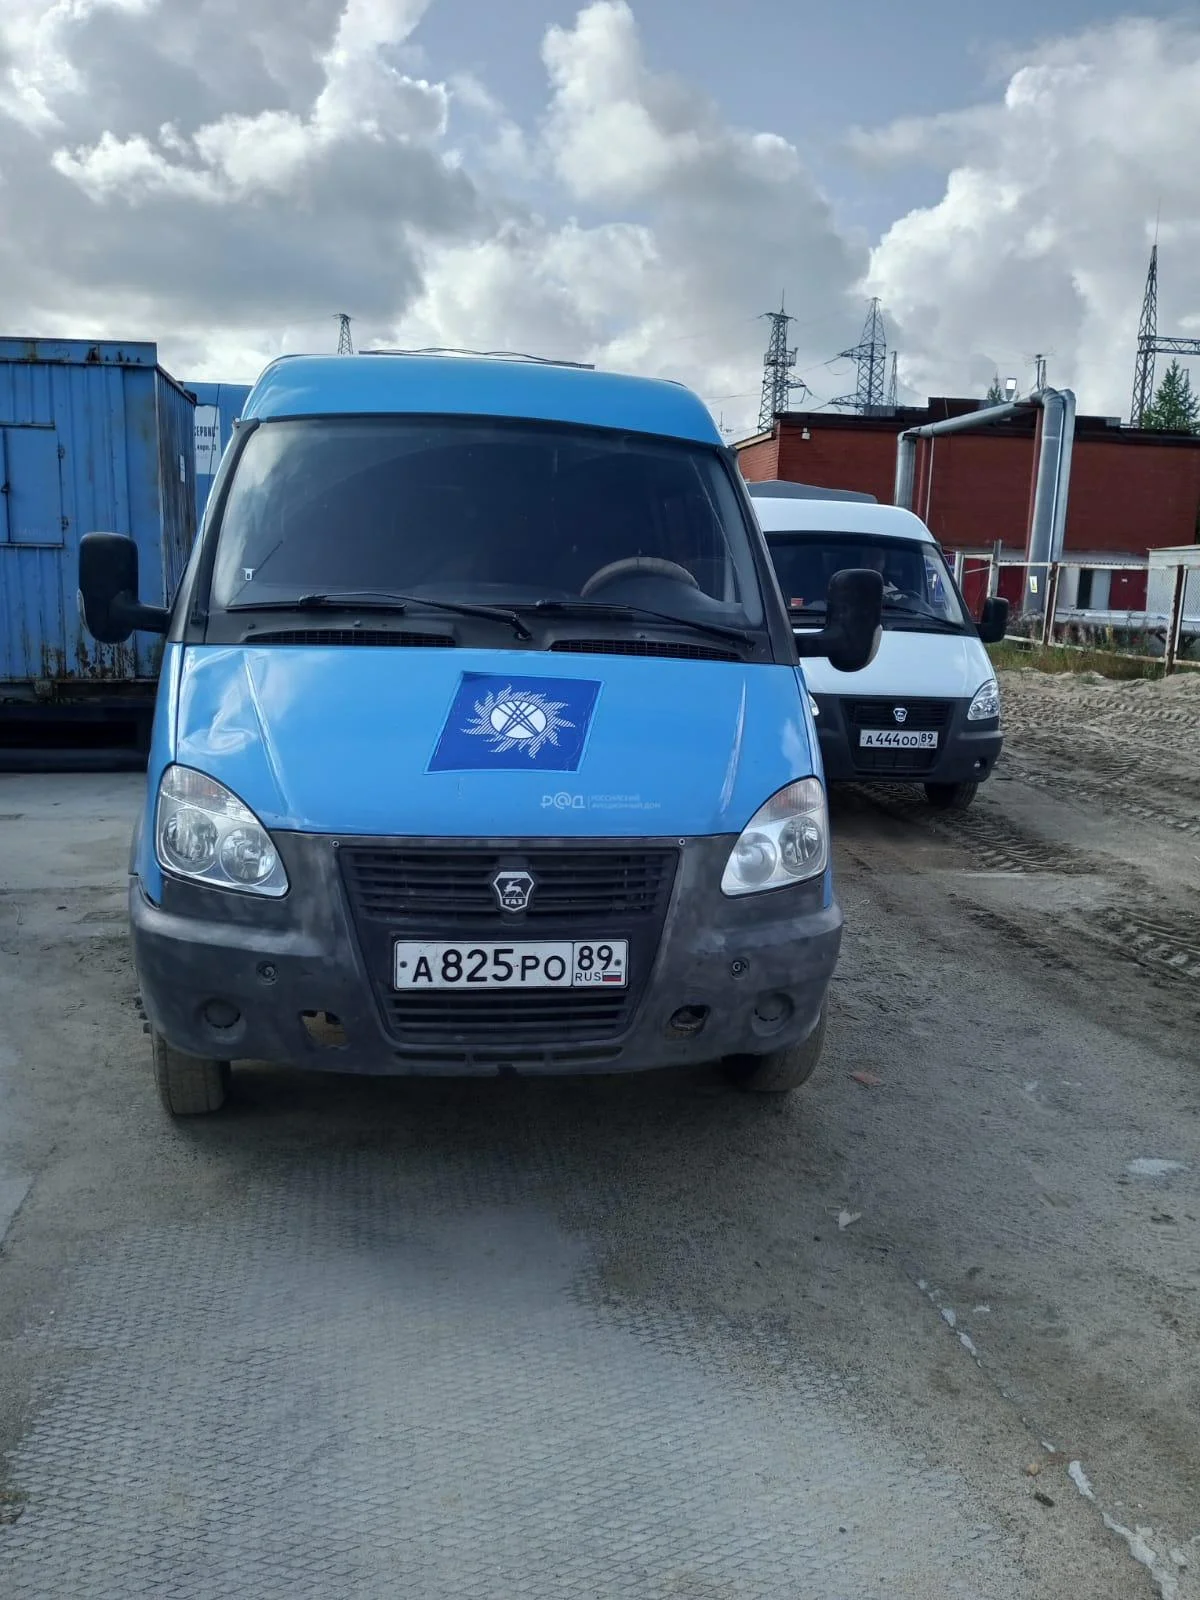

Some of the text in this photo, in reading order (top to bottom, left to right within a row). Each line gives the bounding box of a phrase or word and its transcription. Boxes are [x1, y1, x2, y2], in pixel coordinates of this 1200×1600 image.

[920, 733, 934, 743] 89
[412, 945, 614, 983] А825РО 89
[575, 971, 602, 982] RUS
